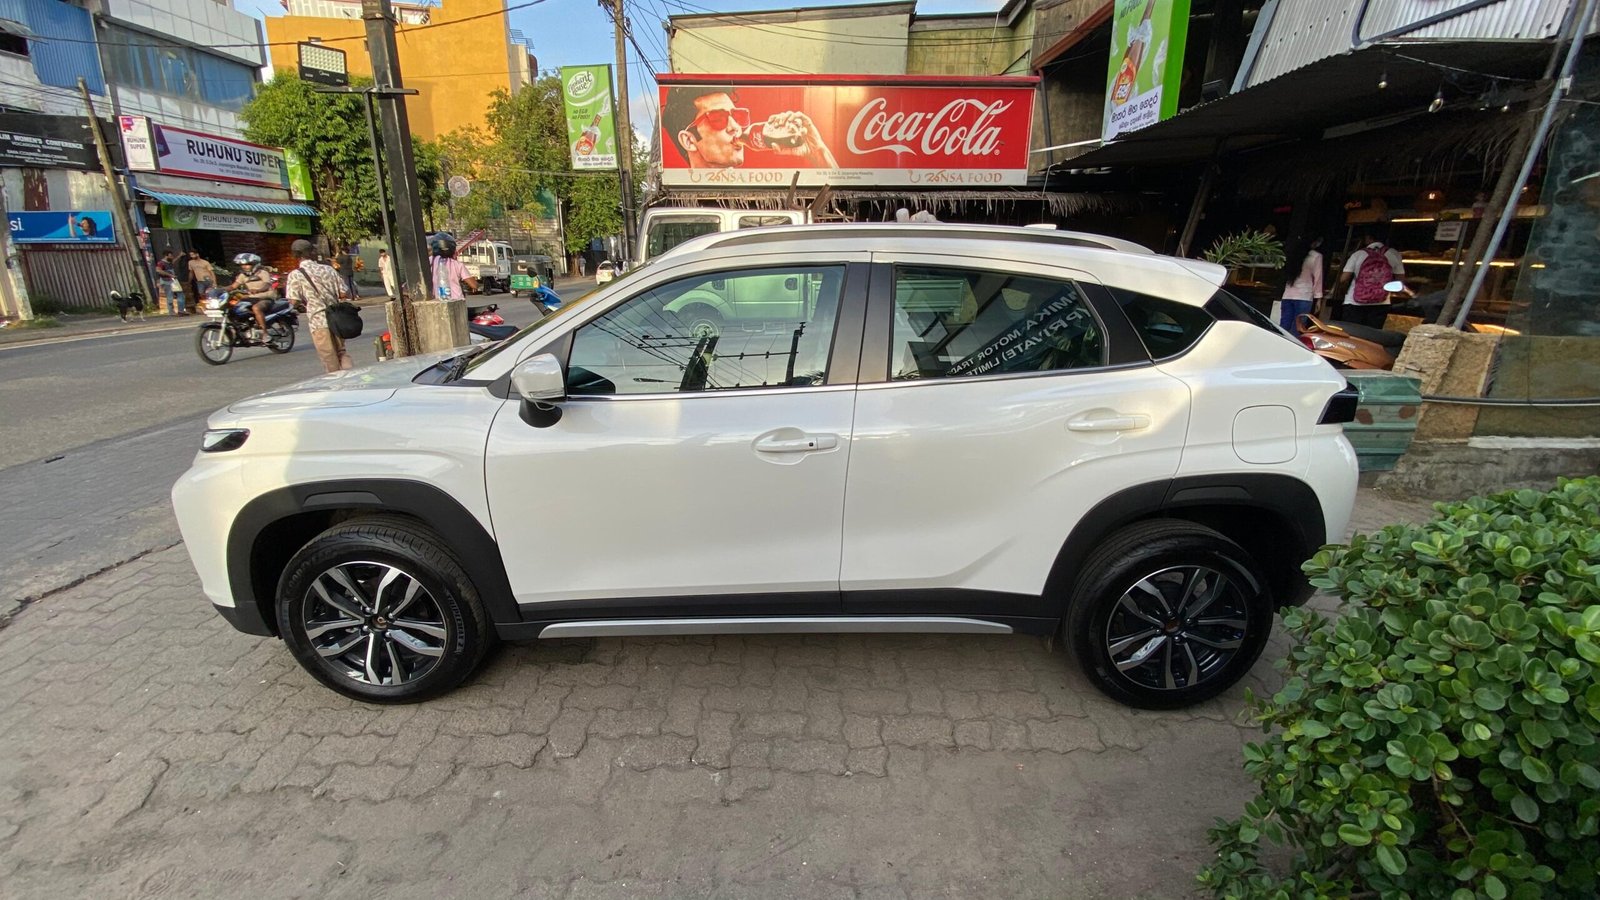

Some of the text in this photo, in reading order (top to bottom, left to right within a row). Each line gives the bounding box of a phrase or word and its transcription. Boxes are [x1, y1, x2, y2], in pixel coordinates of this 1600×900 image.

[846, 97, 1014, 156] Coca-Cola
[45, 139, 84, 150] CONFERENCE
[186, 138, 242, 162] RUHUNU
[244, 150, 281, 169] SUPER
[748, 171, 783, 183] FOOD
[967, 172, 1003, 183] FOOD
[202, 214, 255, 225] RUHUNU SUPER
